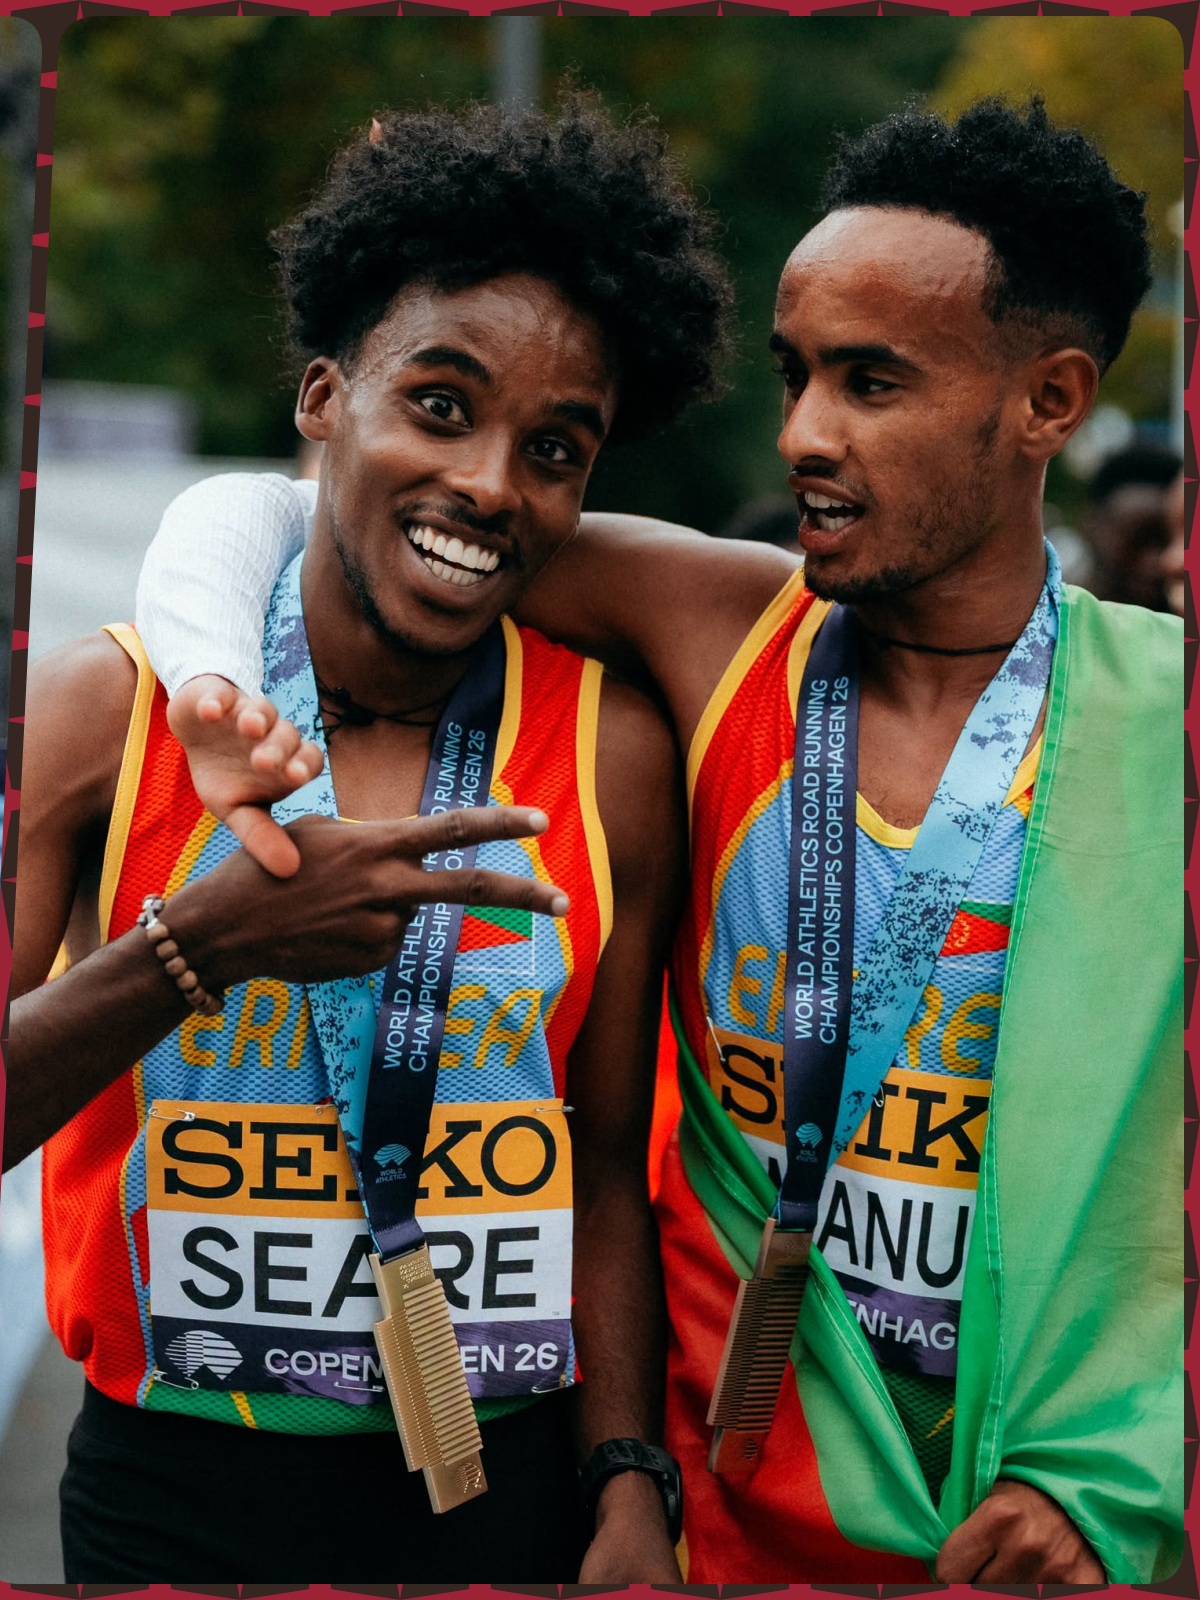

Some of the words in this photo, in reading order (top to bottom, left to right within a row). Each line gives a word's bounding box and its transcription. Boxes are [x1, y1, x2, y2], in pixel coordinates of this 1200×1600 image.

[804, 679, 828, 768] RUNNING
[831, 676, 849, 701] 26
[802, 772, 820, 834] ROAD
[825, 705, 846, 855] COPENHAGEN
[383, 988, 412, 1069] WORLD
[433, 721, 463, 803] RUNNING
[408, 902, 452, 1072] CHAMPIONSHIP
[467, 729, 486, 752] 26
[798, 838, 819, 957] ATHLETICS
[819, 859, 842, 1045] CHAMPIONSHIPS
[794, 961, 815, 1040] WORLD
[720, 1043, 990, 1173] SIK
[160, 1115, 558, 1202] SEKO
[180, 1226, 540, 1318] SEARE
[264, 1344, 505, 1382] COPENEN
[514, 1342, 559, 1372] 26
